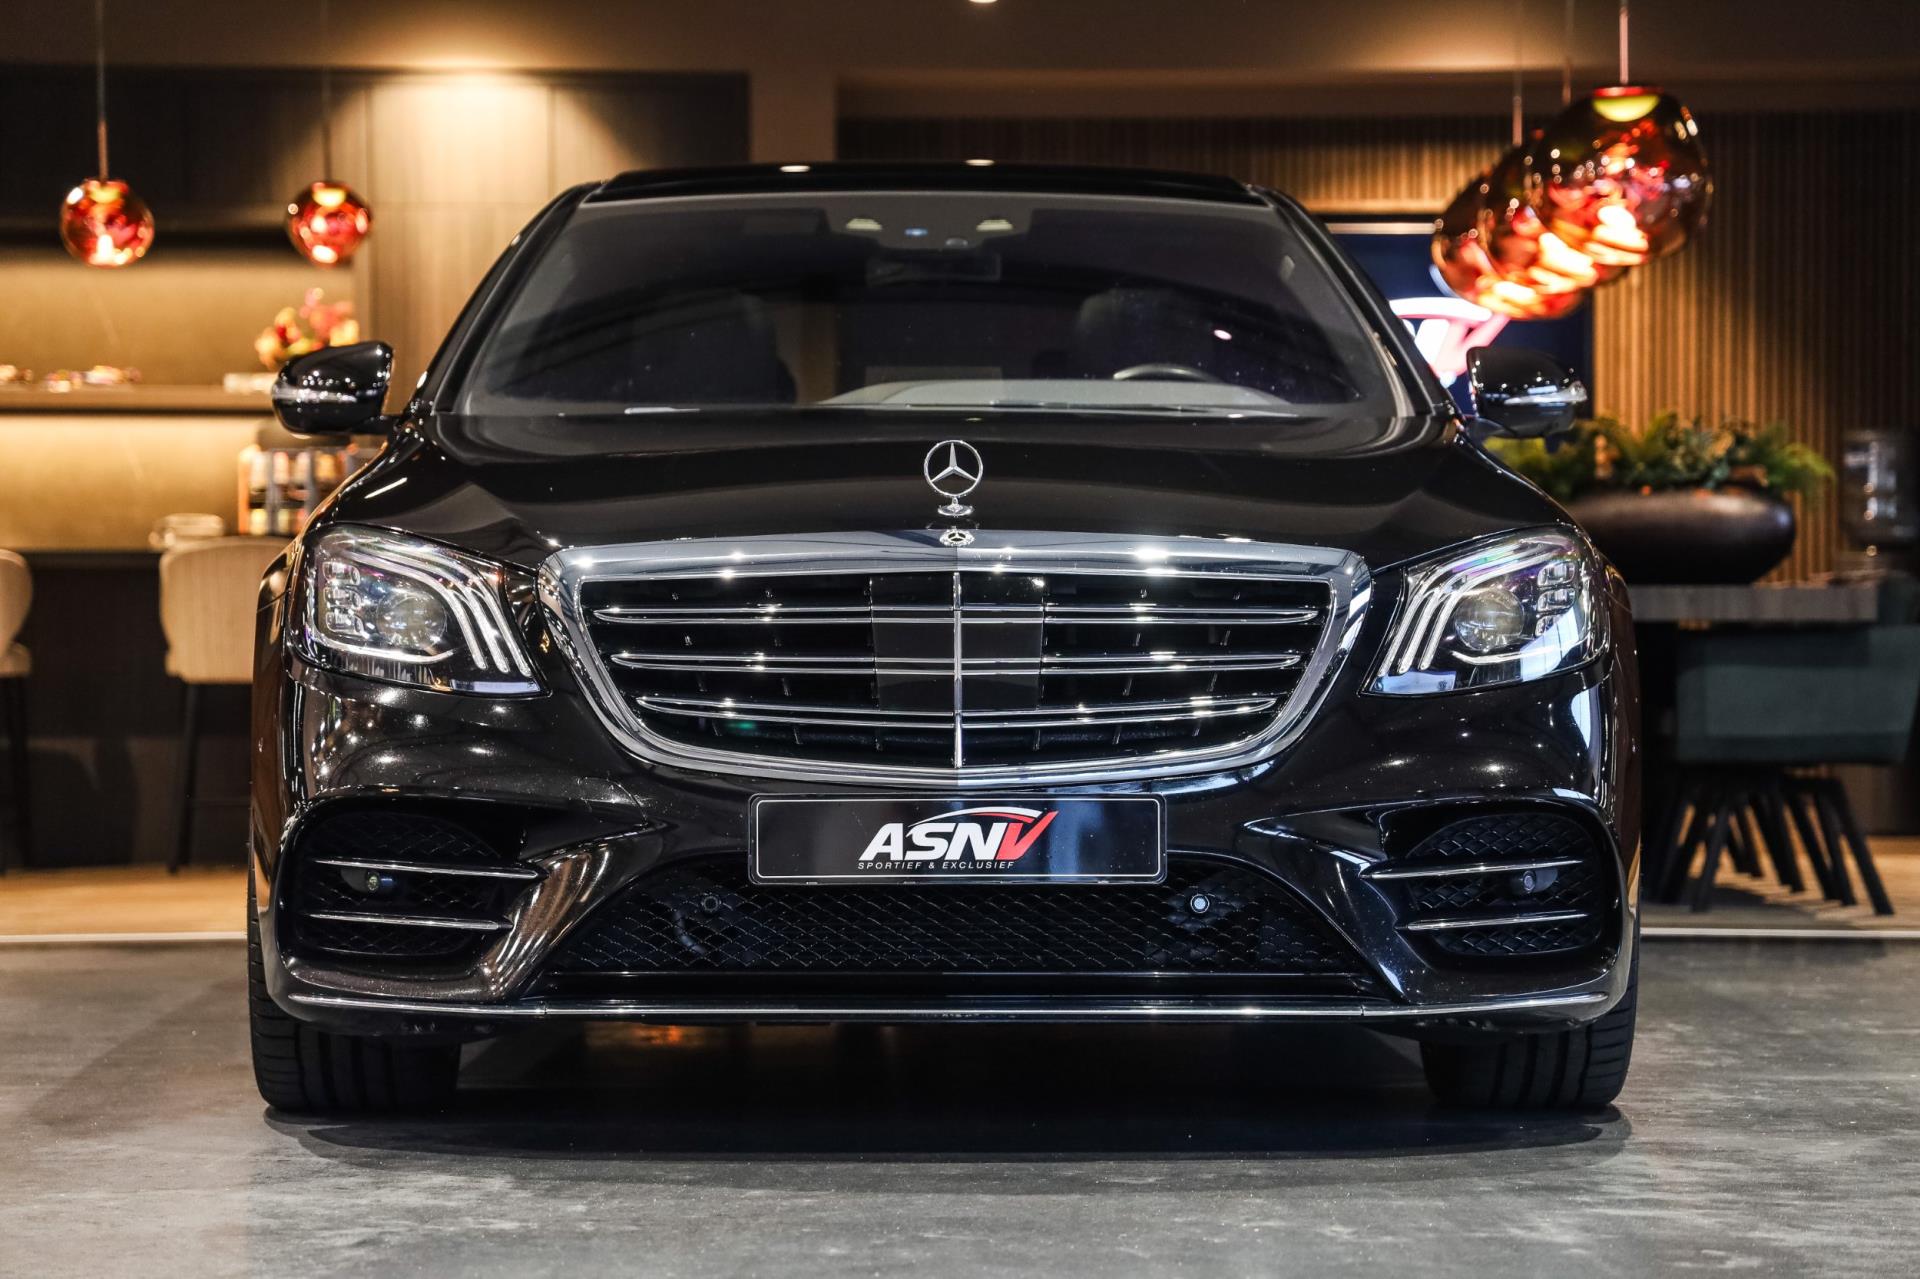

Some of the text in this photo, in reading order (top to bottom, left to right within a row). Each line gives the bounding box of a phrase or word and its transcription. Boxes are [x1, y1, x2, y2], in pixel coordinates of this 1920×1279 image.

[858, 808, 1059, 861] ASNV
[857, 861, 1015, 870] SPORTIEF & EXCLUSIEF
